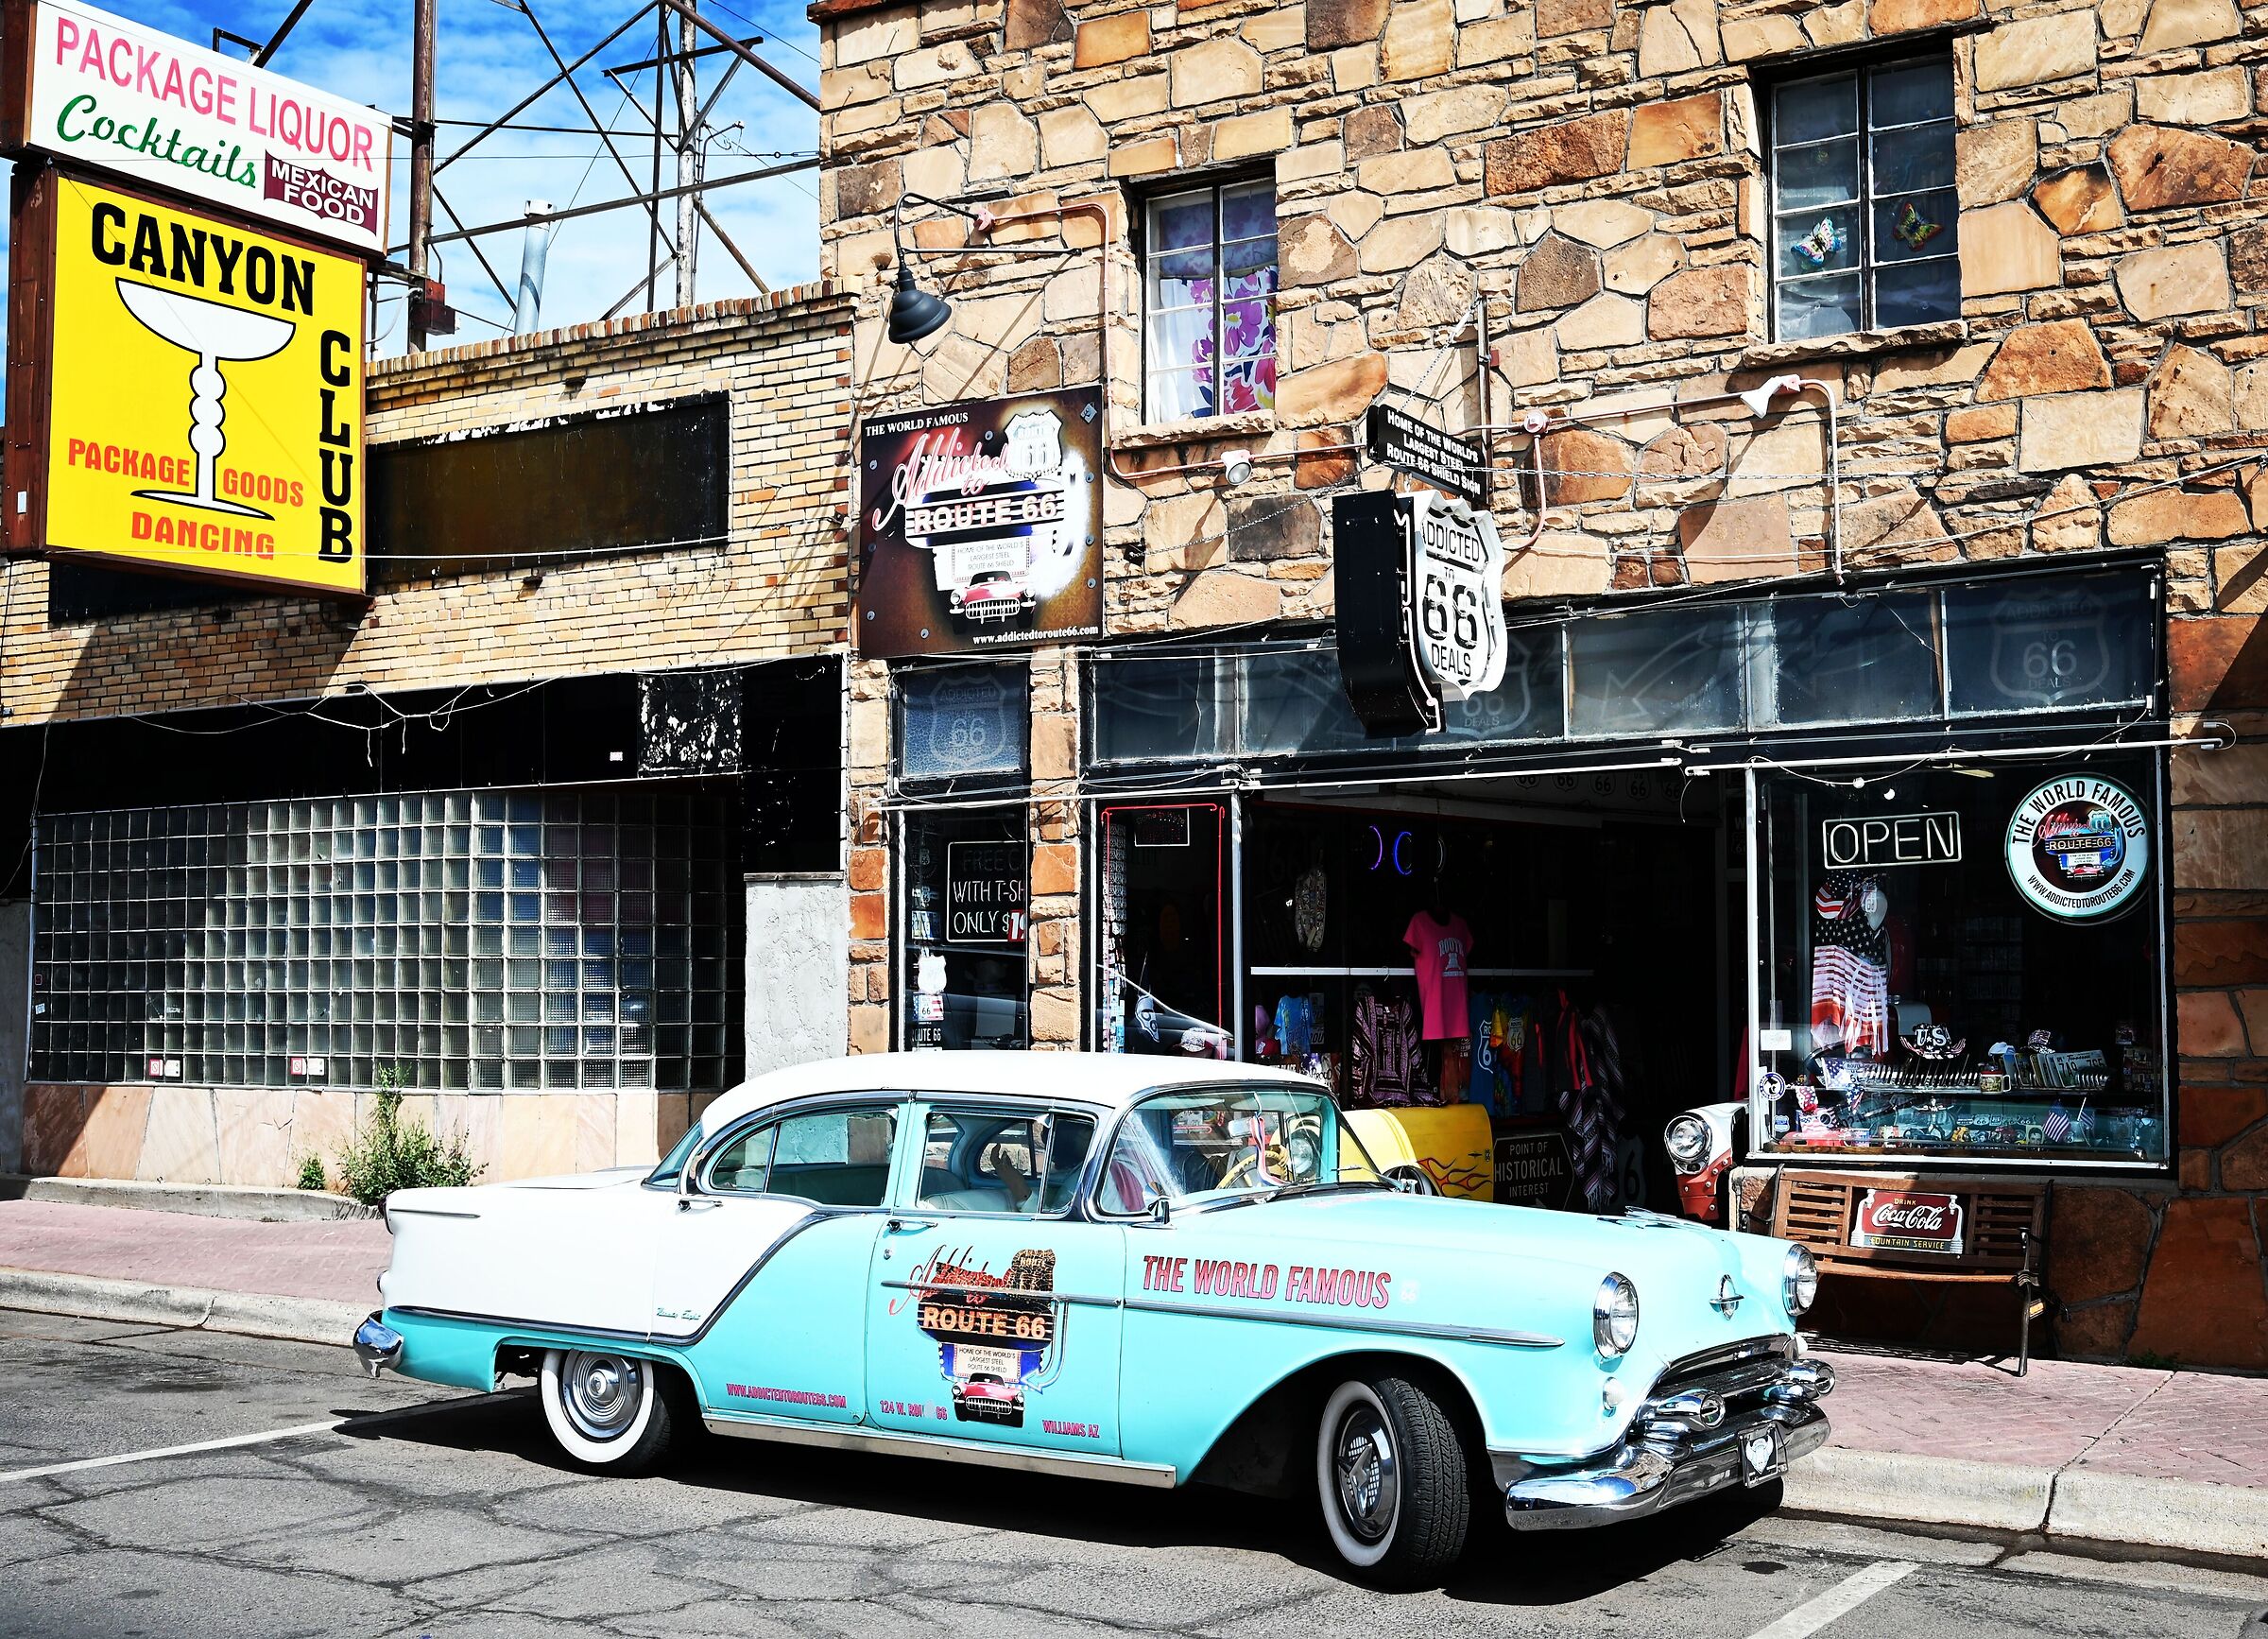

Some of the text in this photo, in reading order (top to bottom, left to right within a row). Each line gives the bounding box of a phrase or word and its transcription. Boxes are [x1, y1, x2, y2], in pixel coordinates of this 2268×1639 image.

[57, 16, 373, 173] PACKAGE LIQUOR
[57, 95, 256, 189] Cocktails
[271, 159, 374, 210] MEXICAN
[284, 186, 365, 226] FOOD
[92, 202, 316, 317] CANYON
[866, 412, 969, 437] THE WORLD FAMOUS
[1387, 410, 1478, 463] HOME OF THE WORLD'S
[68, 439, 189, 487] PACKAGE
[318, 329, 352, 564] CLUB
[1403, 433, 1466, 473] LARGEST STEEL
[872, 427, 1008, 531] Addicted
[1387, 442, 1481, 494] ROUTE 66 SHIELD SIGN
[223, 468, 303, 508] GOODS
[914, 493, 1057, 533] ROUTE 66
[131, 511, 275, 561] DANCING
[1444, 567, 1455, 583] TO
[1422, 574, 1477, 649] 66
[972, 626, 1099, 646] www.addictedtoroute66.com
[1432, 644, 1471, 678] DEALS
[2023, 640, 2077, 679] 66
[2029, 676, 2070, 690] DEALS
[952, 718, 986, 747] 66
[1464, 716, 1500, 727] DEALS
[2012, 780, 2146, 845] THE WORLD FAMOUS
[1830, 816, 1955, 864] OPEN
[2049, 837, 2112, 850] ROUTE 66
[963, 850, 1005, 873] FREE
[953, 880, 992, 904] WITH
[2027, 869, 2136, 908] WWW.ADDICTEDTOROUTE66.COM
[954, 911, 999, 934] ONLY
[933, 1027, 941, 1042] 66
[1509, 1141, 1548, 1156] POINT OF
[1495, 1157, 1563, 1182] HISTORICAL
[1509, 1182, 1550, 1199] INTEREST
[1894, 1198, 1916, 1206] DRINK
[1871, 1203, 1947, 1231] Coca-Cola
[1871, 1236, 1945, 1251] FOUNTAIN SERVICE
[1143, 1255, 1392, 1309] THE WORLD FAMOUS
[923, 1306, 1046, 1339] ROUTE 66
[726, 1383, 847, 1408] WWW.ADDICTEDTOROUTE66.COM
[879, 1400, 895, 1414] 124
[897, 1402, 907, 1415] W.
[936, 1406, 947, 1420] 66
[1042, 1419, 1099, 1438] WILLIAMS AZ
